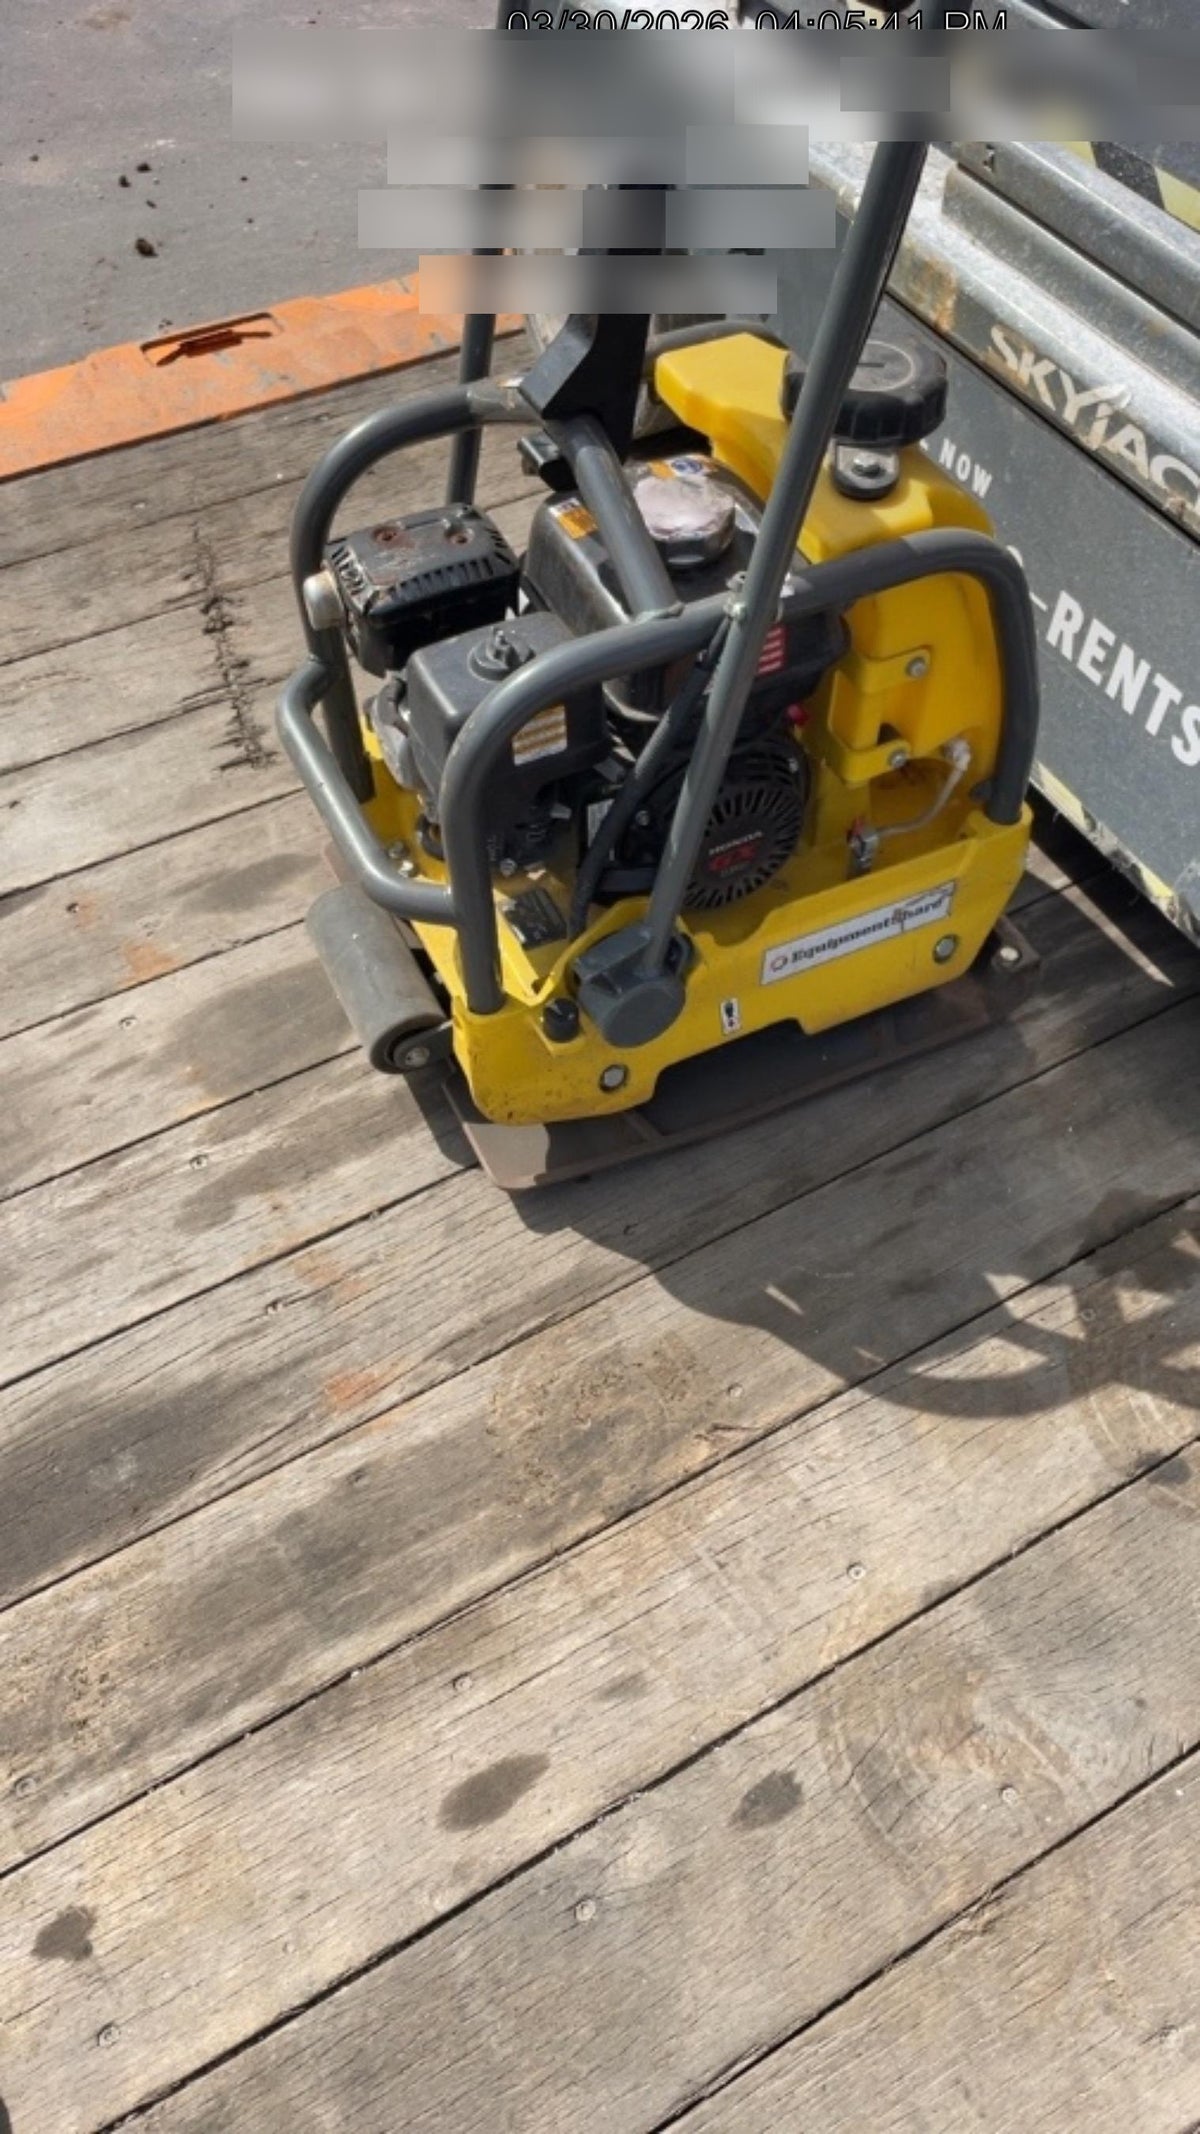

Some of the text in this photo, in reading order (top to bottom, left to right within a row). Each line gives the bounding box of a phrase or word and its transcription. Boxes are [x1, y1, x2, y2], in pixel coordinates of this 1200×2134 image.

[938, 437, 993, 499] NOW
[986, 324, 1200, 519] SKYJAC
[1006, 545, 1200, 767] -RENTS
